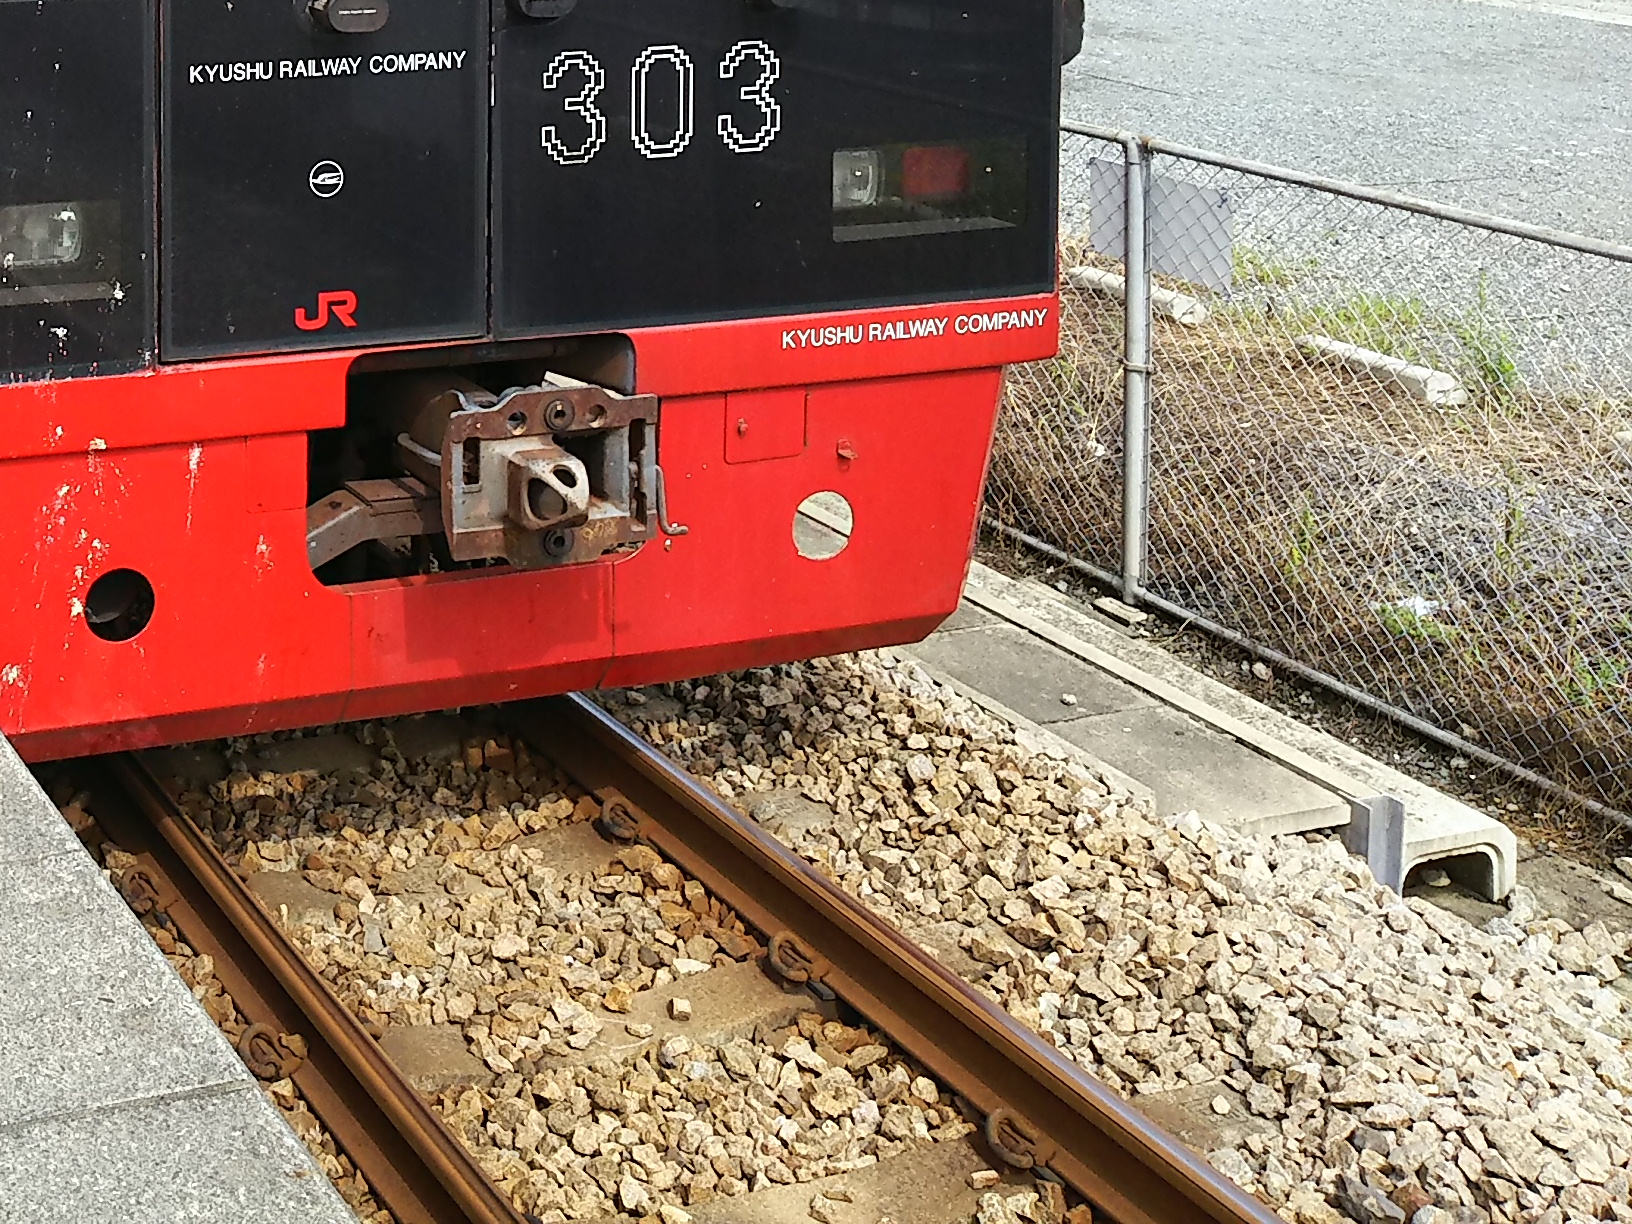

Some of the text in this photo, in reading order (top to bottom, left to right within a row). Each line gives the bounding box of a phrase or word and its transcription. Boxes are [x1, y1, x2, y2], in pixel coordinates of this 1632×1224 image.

[189, 51, 467, 84] KYUSHU RAILWAY COMPANY
[541, 40, 781, 165] 303
[294, 290, 358, 331] JR
[781, 308, 1049, 350] KYUSHU RAILWAY COMPANY
